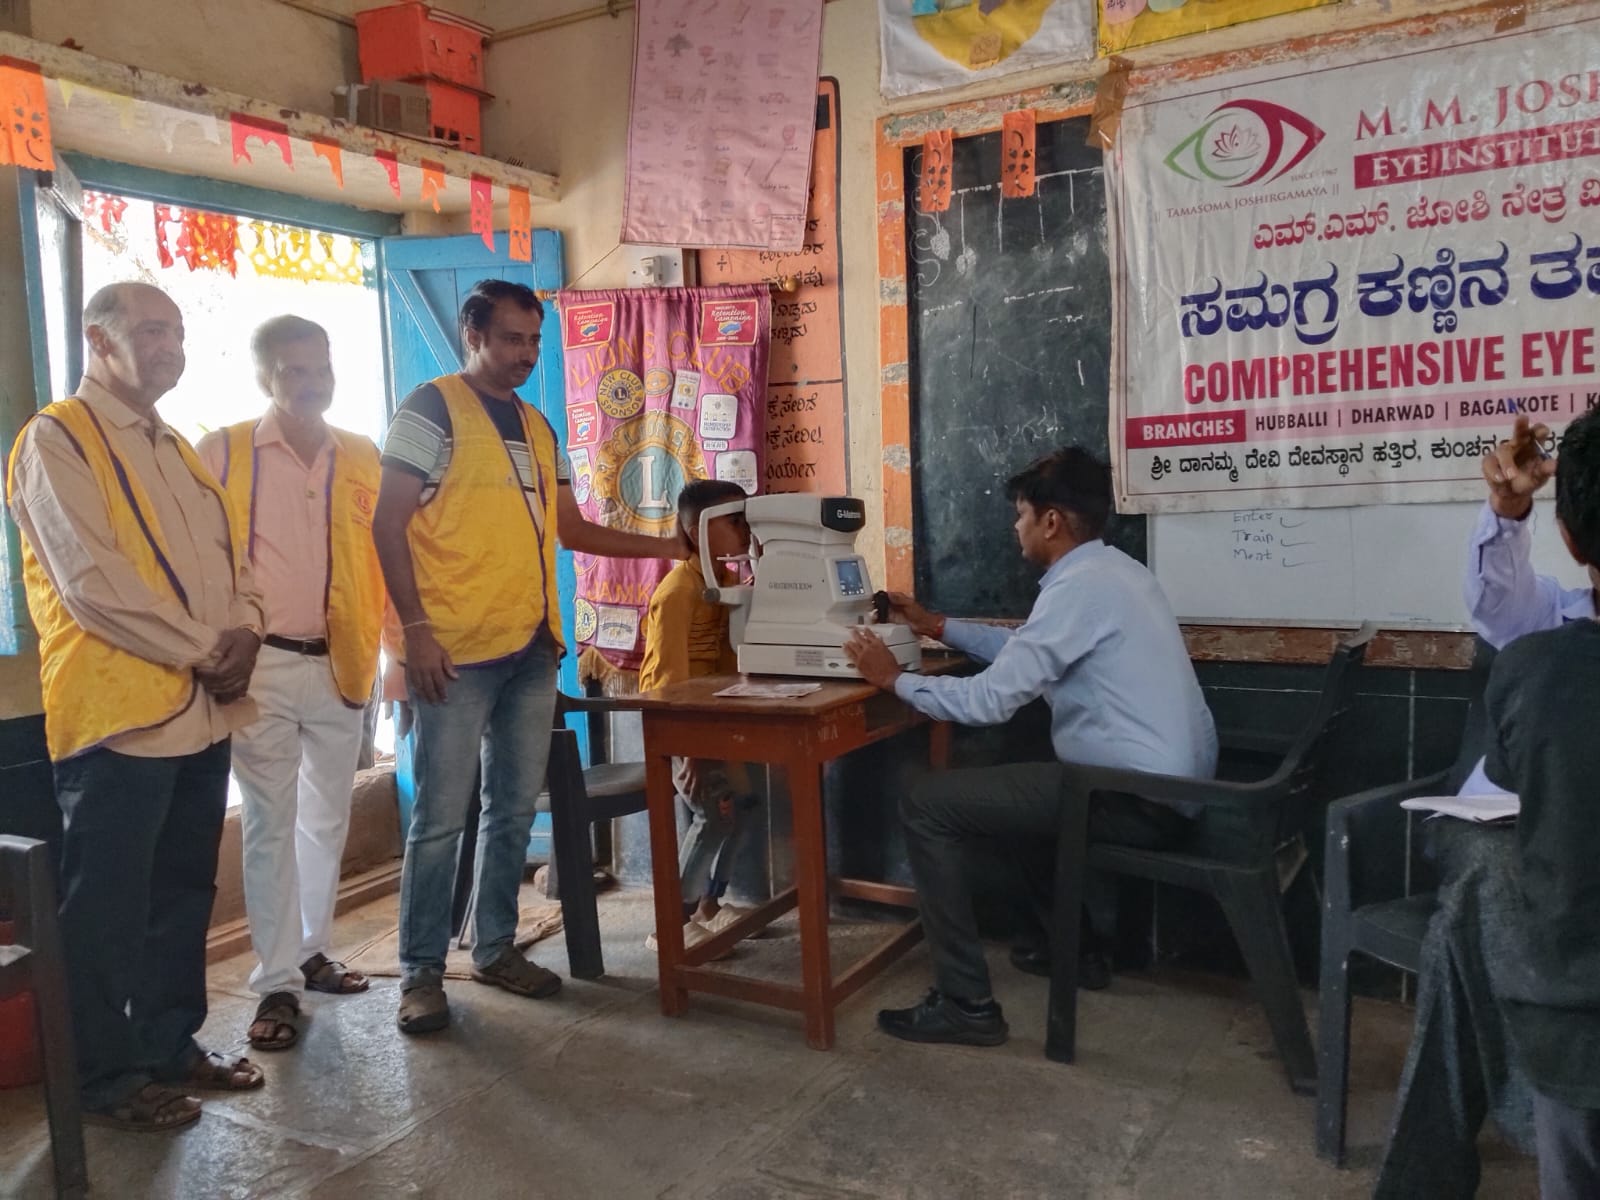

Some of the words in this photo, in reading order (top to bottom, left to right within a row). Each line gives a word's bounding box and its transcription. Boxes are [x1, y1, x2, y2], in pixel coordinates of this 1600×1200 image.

[1355, 105, 1407, 141] M.
[1423, 94, 1478, 131] M.
[1372, 151, 1430, 182] EYE
[1167, 202, 1231, 218] TAMASOMA
[1234, 187, 1328, 209] JOSHIRGAMAYA
[1406, 189, 1490, 229] ಜೋಶಿ
[1502, 178, 1567, 223] ನೇತ್ರ
[1180, 260, 1340, 346] ಸಮಗ್ರ
[1357, 239, 1510, 335] ಕಣ್ಣಿನ
[571, 331, 655, 388] LIONS
[667, 329, 751, 395] CLUB
[1184, 333, 1506, 405] COMPREHENSIVE
[1521, 327, 1597, 379] EYE
[600, 374, 616, 396] NEW
[619, 371, 643, 394] CLUB
[1142, 418, 1236, 441] BRANCHES
[1255, 410, 1328, 432] HUBBALLI
[1351, 403, 1435, 425] DHARWAD
[637, 455, 671, 509] L
[1150, 454, 1172, 481] ಶ್ರೀ
[1179, 449, 1239, 483] ದಾನಮ್ಮ
[1245, 447, 1281, 470] ದೇವಿ
[1288, 443, 1364, 478] ದೇವಸ್ಥಾನ
[587, 579, 651, 603] JAMK
